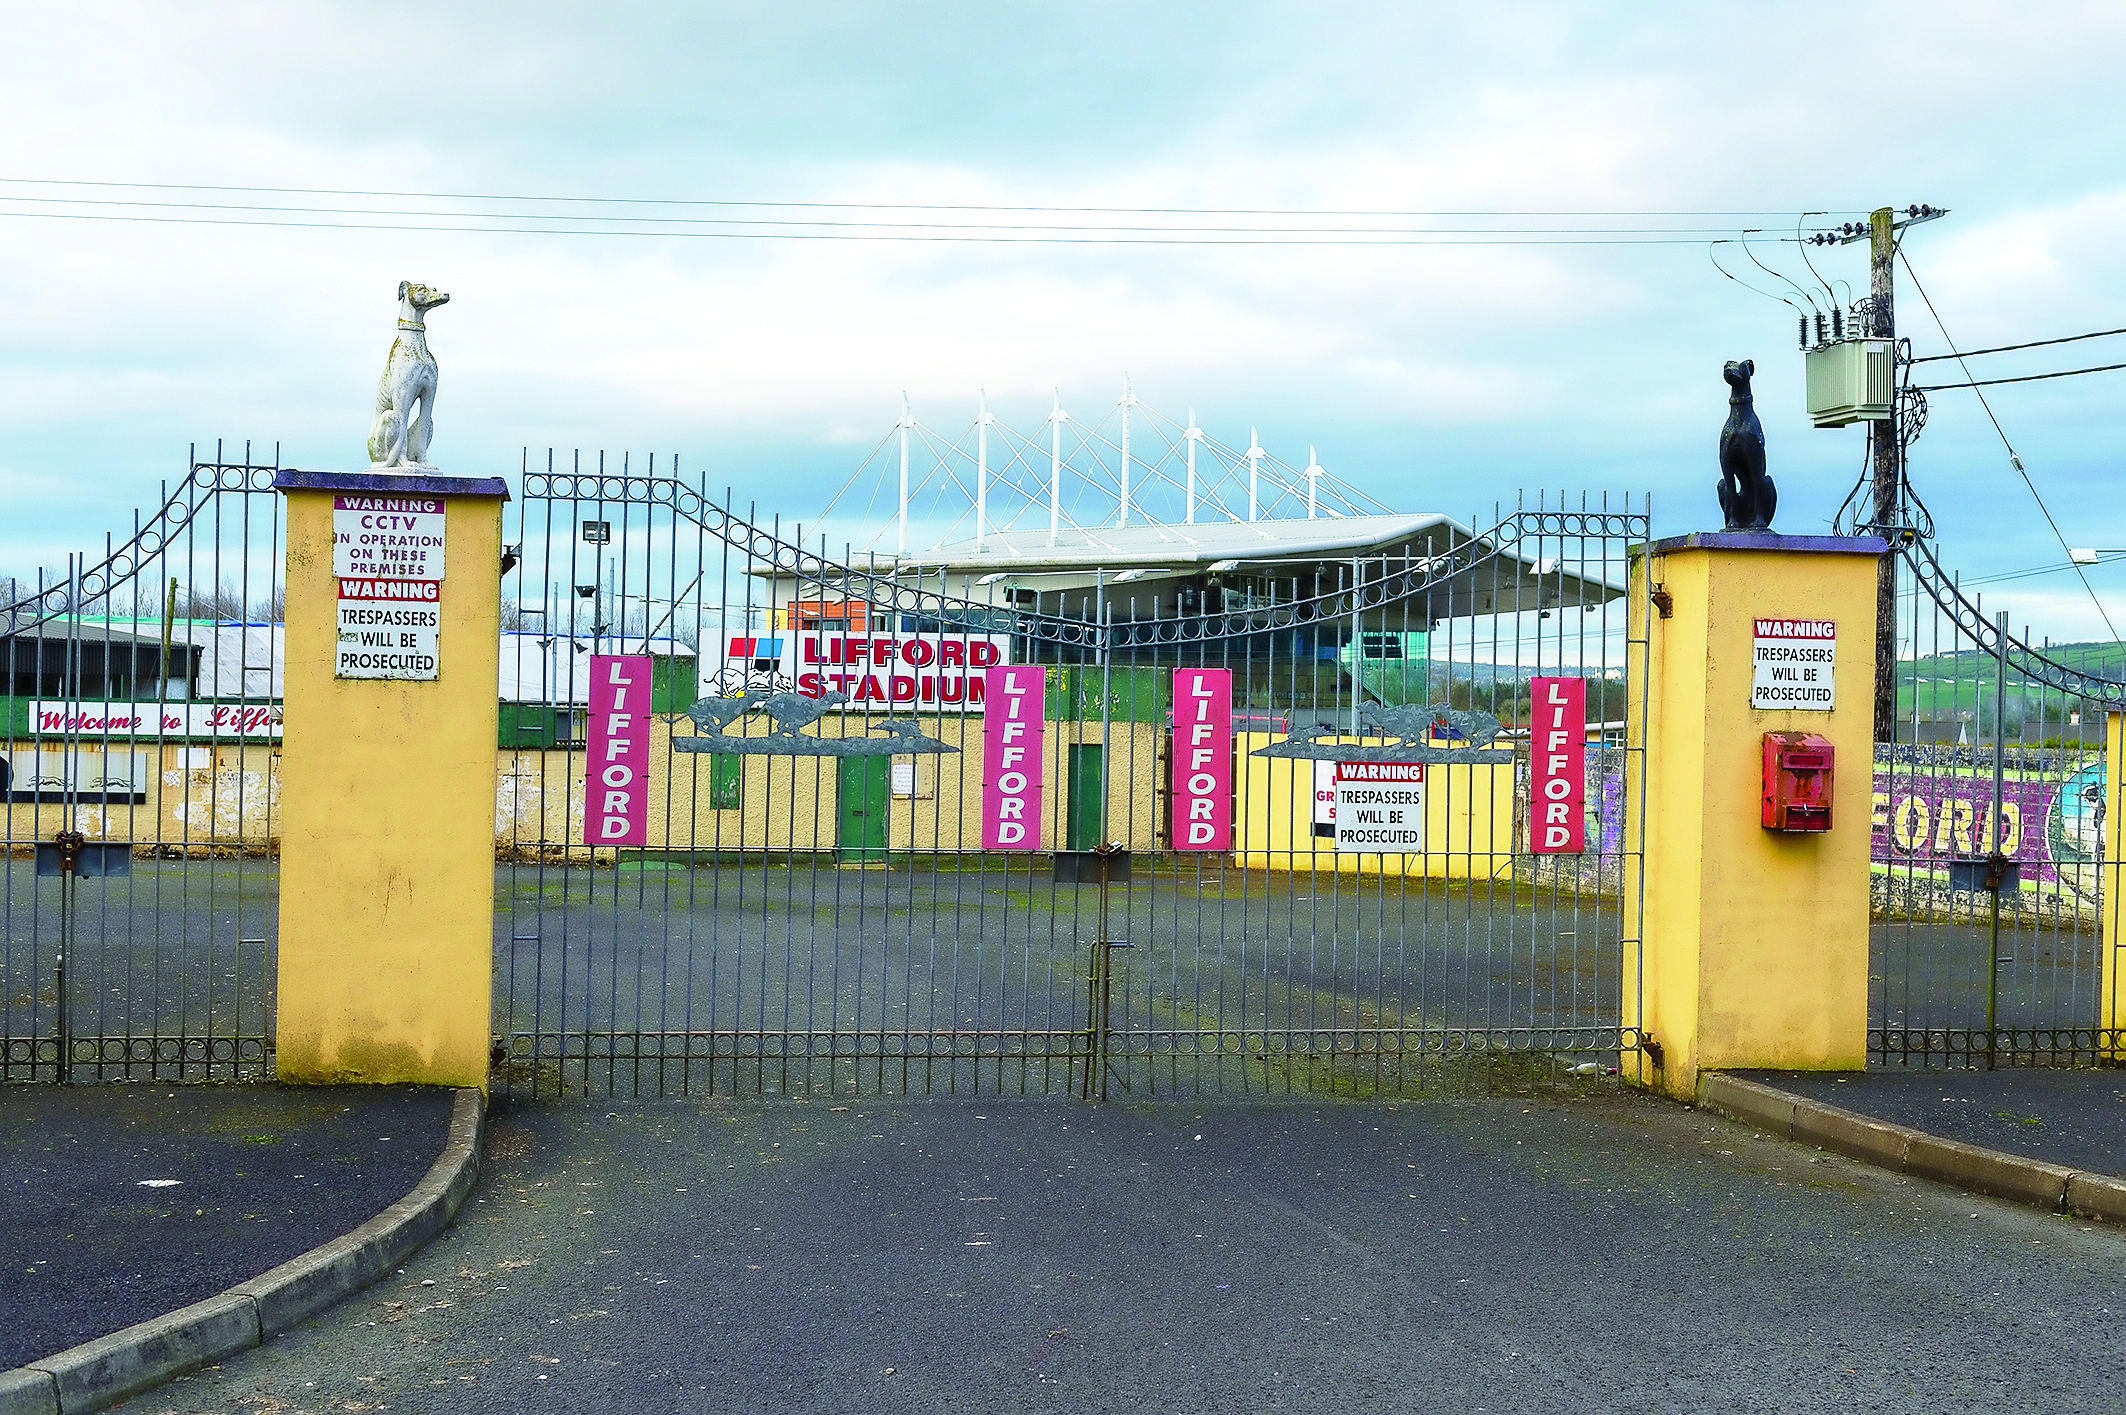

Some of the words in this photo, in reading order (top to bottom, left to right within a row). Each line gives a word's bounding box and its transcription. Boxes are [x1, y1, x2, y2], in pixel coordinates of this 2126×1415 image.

[344, 497, 436, 512] WARNING
[361, 515, 417, 530] CCTV
[334, 533, 350, 544] IN
[360, 534, 442, 547] OPERATION
[350, 548, 373, 559] ON
[382, 549, 426, 561] THESE
[351, 562, 425, 575] PREMISES
[342, 581, 437, 599] WARNING
[342, 609, 437, 627] TRESPASSERS
[1757, 621, 1834, 638] WARNING
[361, 631, 393, 647] WILL
[400, 633, 417, 648] BE
[804, 637, 1001, 668] LIFFORD
[1756, 647, 1833, 663] TRESPASSERS
[340, 653, 434, 670] PROSECUTED
[1771, 667, 1798, 681] WILL
[1803, 668, 1818, 682] BE
[1755, 686, 1831, 701] PROSECUTED
[40, 710, 142, 730] Welcome
[163, 713, 182, 729] to
[205, 706, 282, 733] Liffo
[601, 662, 633, 839] LIFFORD
[997, 672, 1027, 844] LIFFORD
[1187, 675, 1216, 845] LIFFORD
[1544, 683, 1571, 848] LIFFORD
[1341, 764, 1420, 780] WARNING
[1340, 790, 1420, 804] TRESPASSERS
[1357, 810, 1384, 824] WILL
[1389, 810, 1403, 824] BE
[1872, 793, 2024, 856] FORD
[1340, 829, 1418, 844] PROSECUTED
